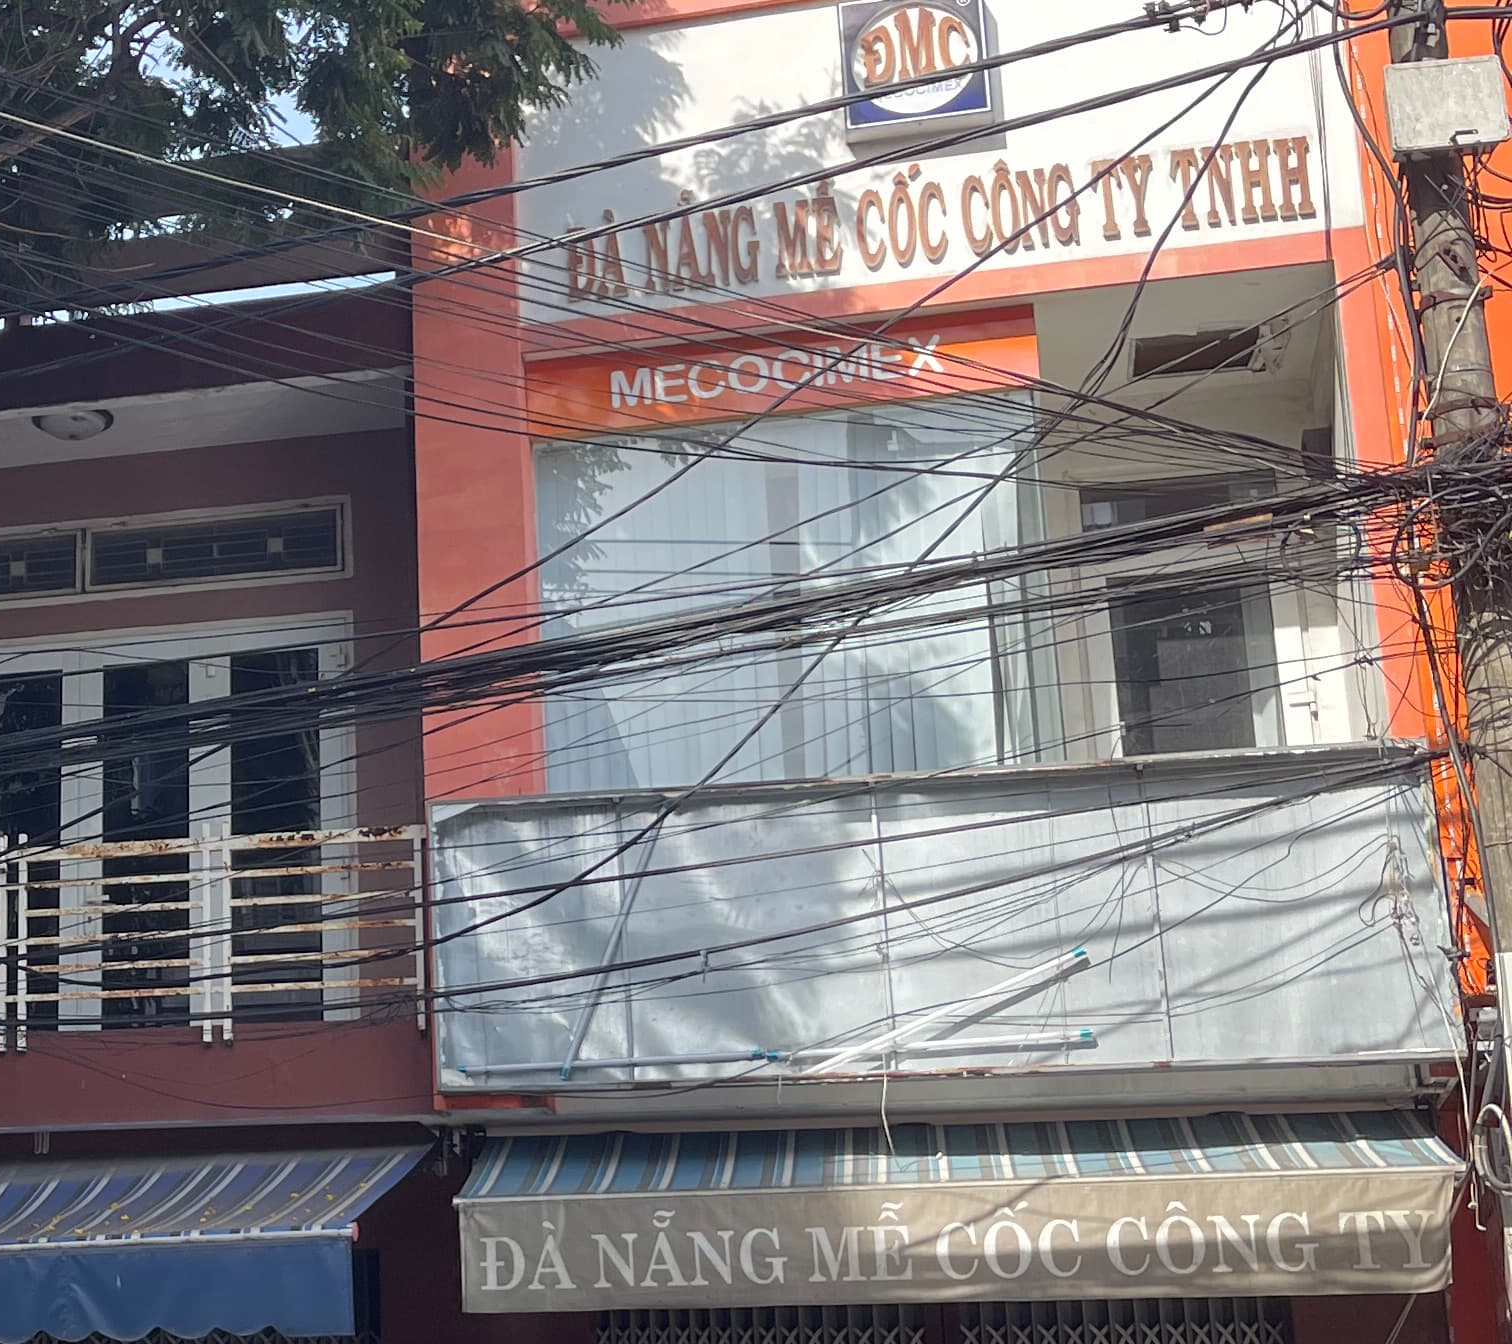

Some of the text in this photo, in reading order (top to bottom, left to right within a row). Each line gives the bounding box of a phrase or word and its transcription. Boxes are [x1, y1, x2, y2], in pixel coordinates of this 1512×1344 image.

[856, 163, 949, 272] CỐC
[961, 158, 1081, 257] CÔNG
[1091, 154, 1153, 241] TY
[1170, 136, 1317, 231] TNHH
[609, 334, 945, 410] MECOCIMEX
[479, 1200, 1435, 1292] ĐÀ NẴNG MỄ CỐC CÔNG TY
